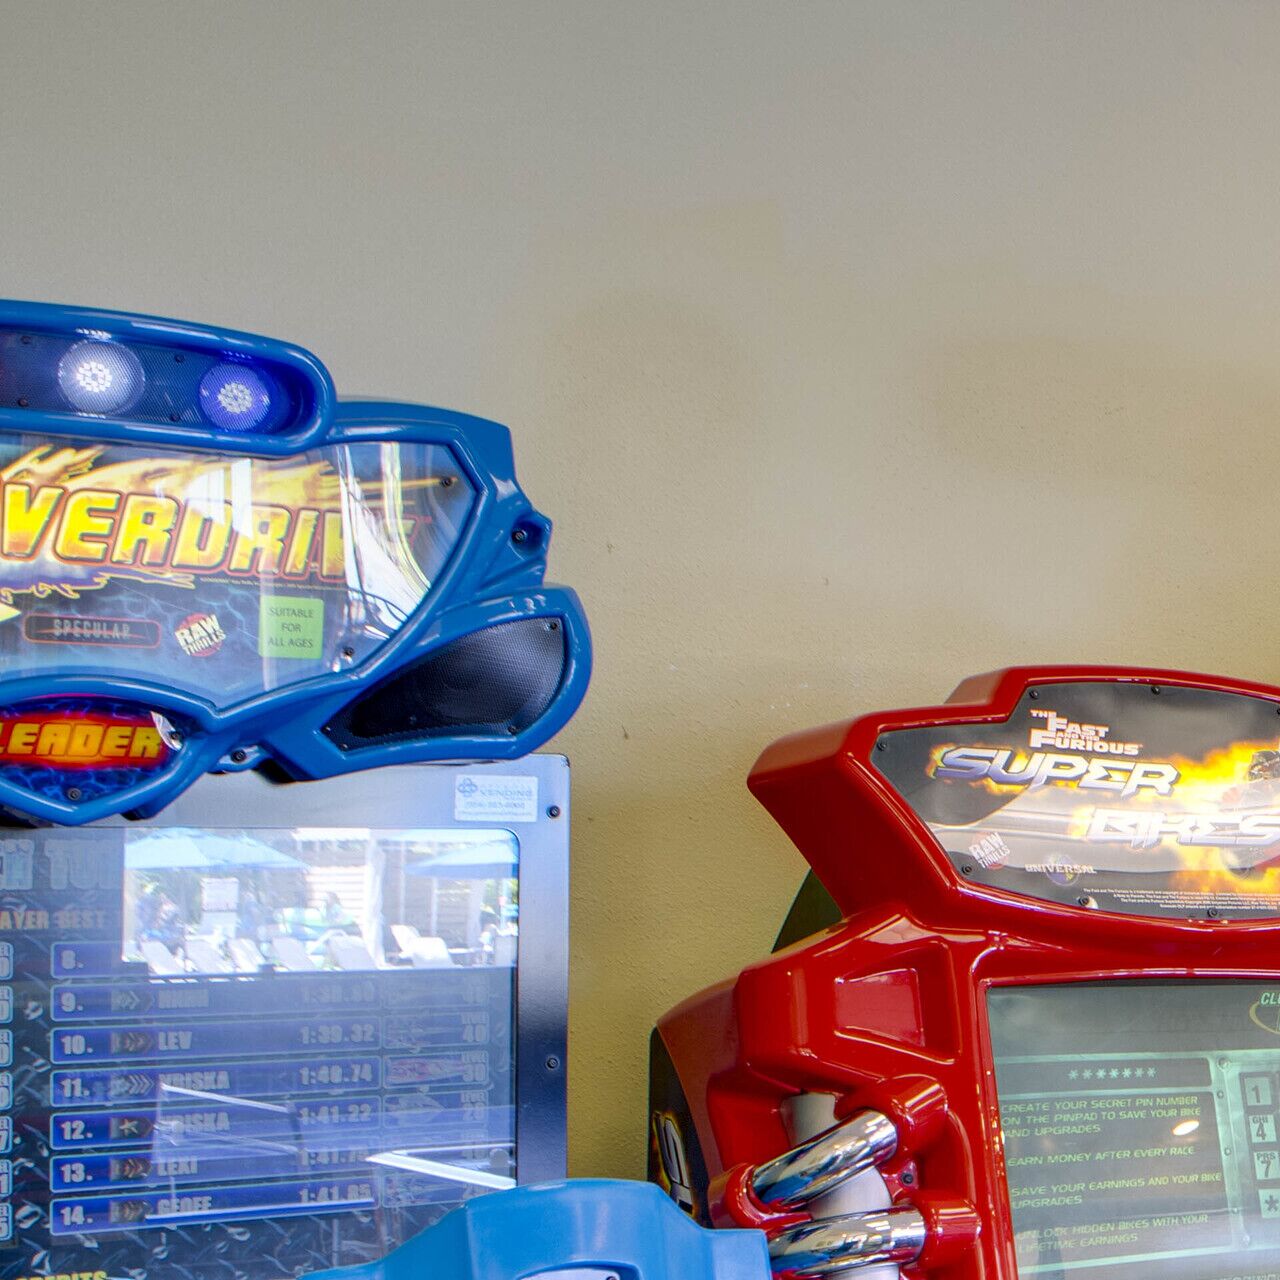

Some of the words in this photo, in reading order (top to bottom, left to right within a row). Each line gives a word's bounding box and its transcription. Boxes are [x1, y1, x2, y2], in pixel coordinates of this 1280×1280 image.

[269, 607, 315, 619] SUITABLE
[53, 619, 130, 640] SPECULAR
[177, 614, 220, 642] RAW
[184, 630, 226, 655] THRILLS
[268, 637, 286, 649] ALL
[288, 637, 314, 649] AGES
[1047, 714, 1110, 739] FAST
[1029, 729, 1140, 756] FURIOUS
[937, 747, 1181, 799] SUPER
[968, 832, 1006, 859] RAW
[978, 842, 1010, 869] THRILLS
[1025, 863, 1096, 876] UNIVERSAL
[61, 1035, 93, 1054] 10.
[61, 1078, 90, 1097] 11.
[1252, 1085, 1261, 1104] 1
[61, 1120, 93, 1140] 12.
[1035, 1124, 1101, 1136] UPGRADES
[1256, 1123, 1267, 1141] 4
[1007, 1156, 1043, 1167] EARN
[1047, 1153, 1091, 1164] MONEY
[1261, 1160, 1271, 1178] 7
[61, 1162, 93, 1183] 13.
[1010, 1186, 1047, 1197] SAVE
[1050, 1183, 1086, 1194] YOUR
[1088, 1178, 1145, 1191] EARNINGS
[1010, 1196, 1082, 1209] UPGRADES
[61, 1206, 94, 1225] 14.
[1072, 1222, 1115, 1236] HIDDEN
[1118, 1219, 1150, 1230] BIKES
